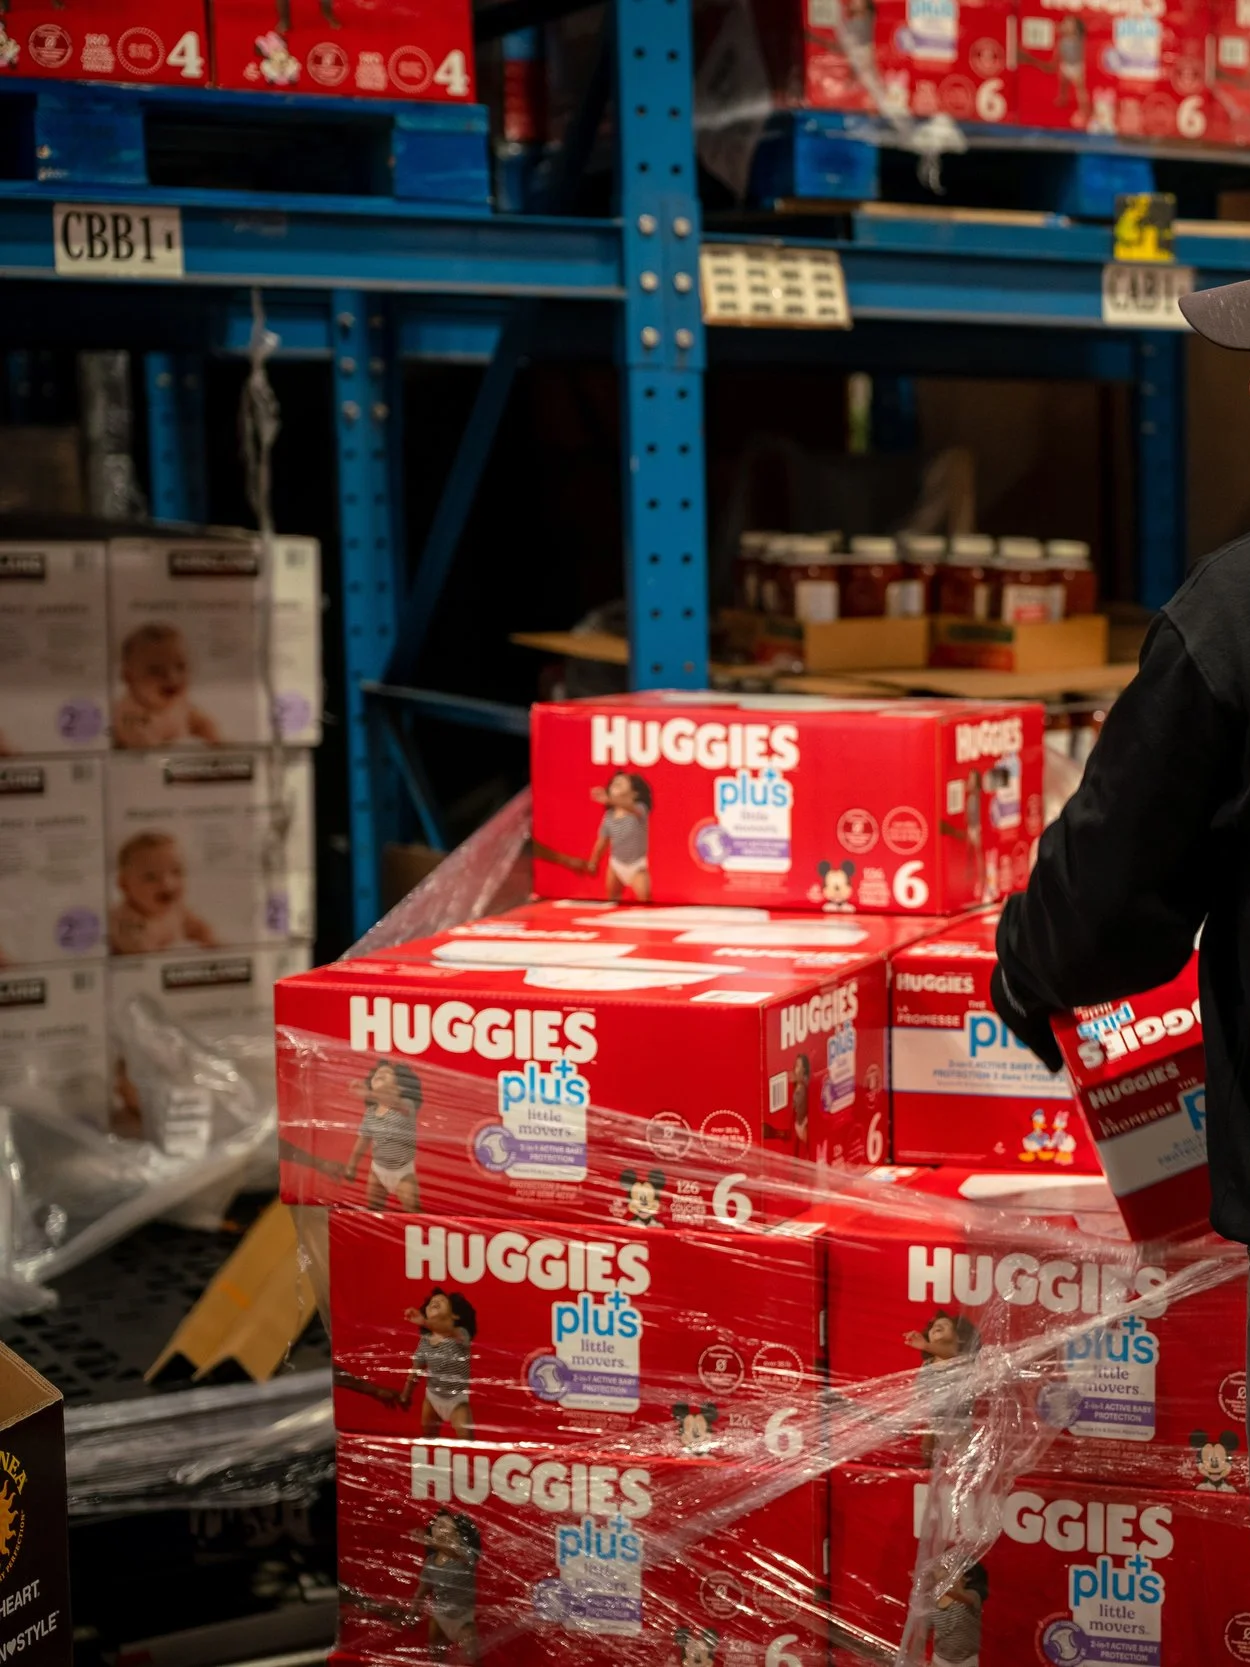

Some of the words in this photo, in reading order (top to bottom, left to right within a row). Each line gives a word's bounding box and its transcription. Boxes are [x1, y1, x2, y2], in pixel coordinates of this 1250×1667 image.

[166, 31, 204, 78] 4
[433, 49, 470, 96] 4
[975, 78, 1007, 122] 6
[1176, 95, 1206, 138] 6
[591, 716, 799, 770] HUGGIES
[719, 772, 788, 812] plus
[893, 861, 929, 908] 6
[896, 972, 975, 994] HUGGIES
[350, 996, 598, 1064] HUGGIES
[780, 980, 858, 1050] HUGGIES
[1077, 998, 1201, 1069] GGIES
[503, 1066, 585, 1111] plus
[1088, 1061, 1180, 1110] HUGGIES
[518, 1124, 572, 1137] movers
[527, 1108, 562, 1122] little
[866, 1112, 883, 1164] 6
[677, 1180, 700, 1194] 126
[713, 1173, 752, 1226] 6
[404, 1225, 651, 1295] HUGGIES
[908, 1245, 1168, 1319] HUGGIES
[556, 1297, 638, 1342] plus
[571, 1355, 625, 1368] movers
[581, 1338, 615, 1354] little
[1066, 1326, 1155, 1368] plus
[1094, 1411, 1142, 1422] PROTECTION
[1105, 1403, 1130, 1412] ACTIVE
[1132, 1405, 1152, 1413] BABY
[764, 1407, 804, 1458] 6
[411, 1446, 653, 1519] HUGGIES
[559, 1520, 640, 1565] plus
[1073, 1560, 1161, 1607] plus
[1089, 1620, 1146, 1635] movers
[1099, 1604, 1136, 1619] little
[766, 1634, 805, 1667] 6
[1100, 1650, 1148, 1662] PROTECTION
[1111, 1642, 1137, 1652] ACTIVE
[1139, 1645, 1159, 1654] BABY
